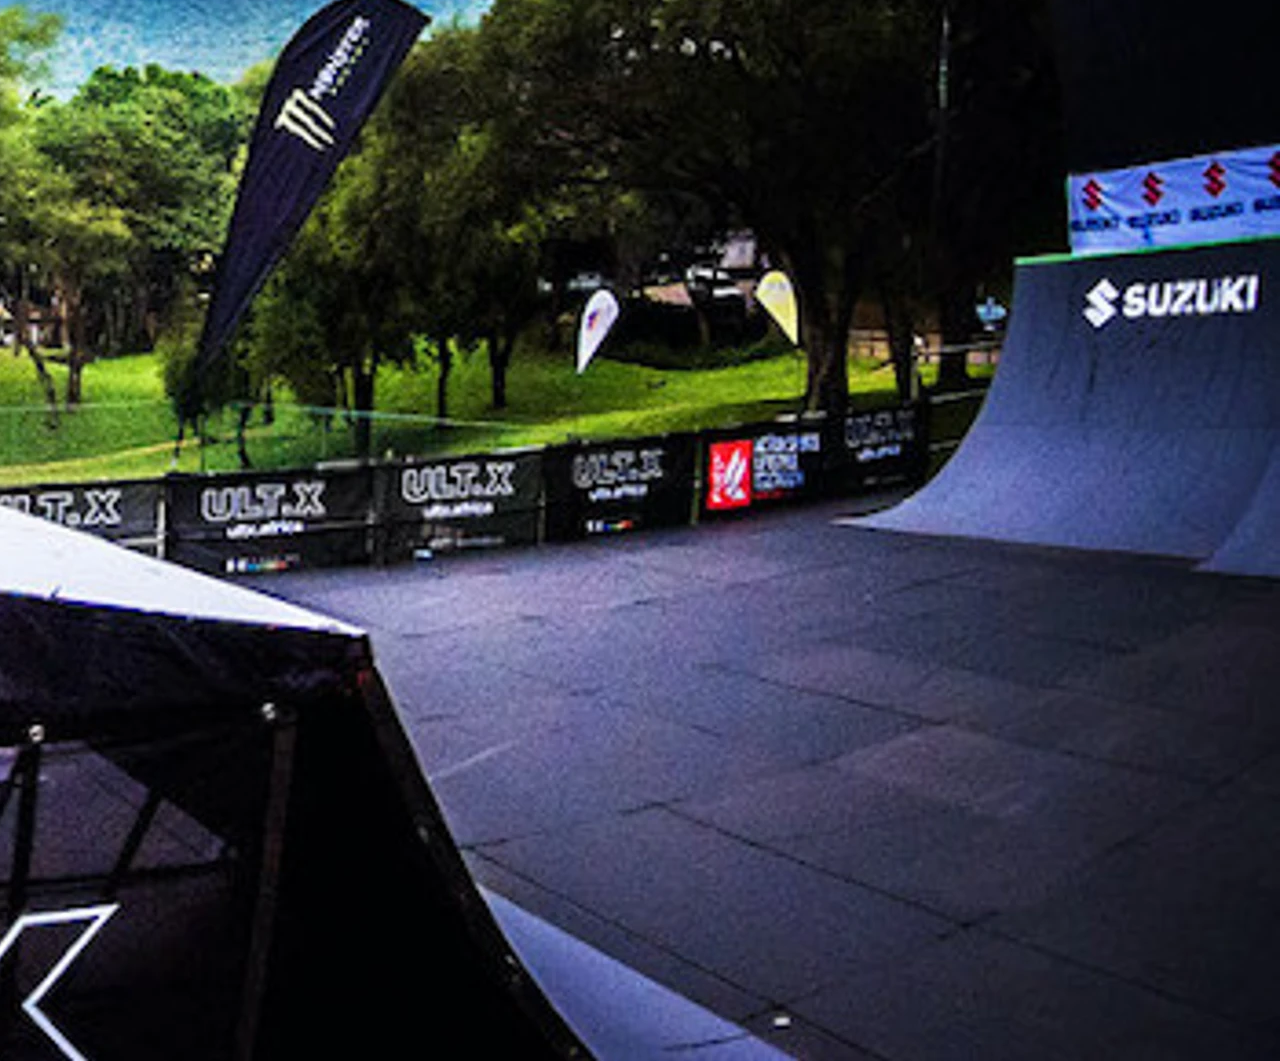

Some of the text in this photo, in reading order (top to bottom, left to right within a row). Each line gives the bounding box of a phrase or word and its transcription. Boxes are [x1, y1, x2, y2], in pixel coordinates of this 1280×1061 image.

[1122, 275, 1259, 318] SUZUKI
[200, 480, 326, 522] ULT.X
[401, 461, 516, 503] ULT.X
